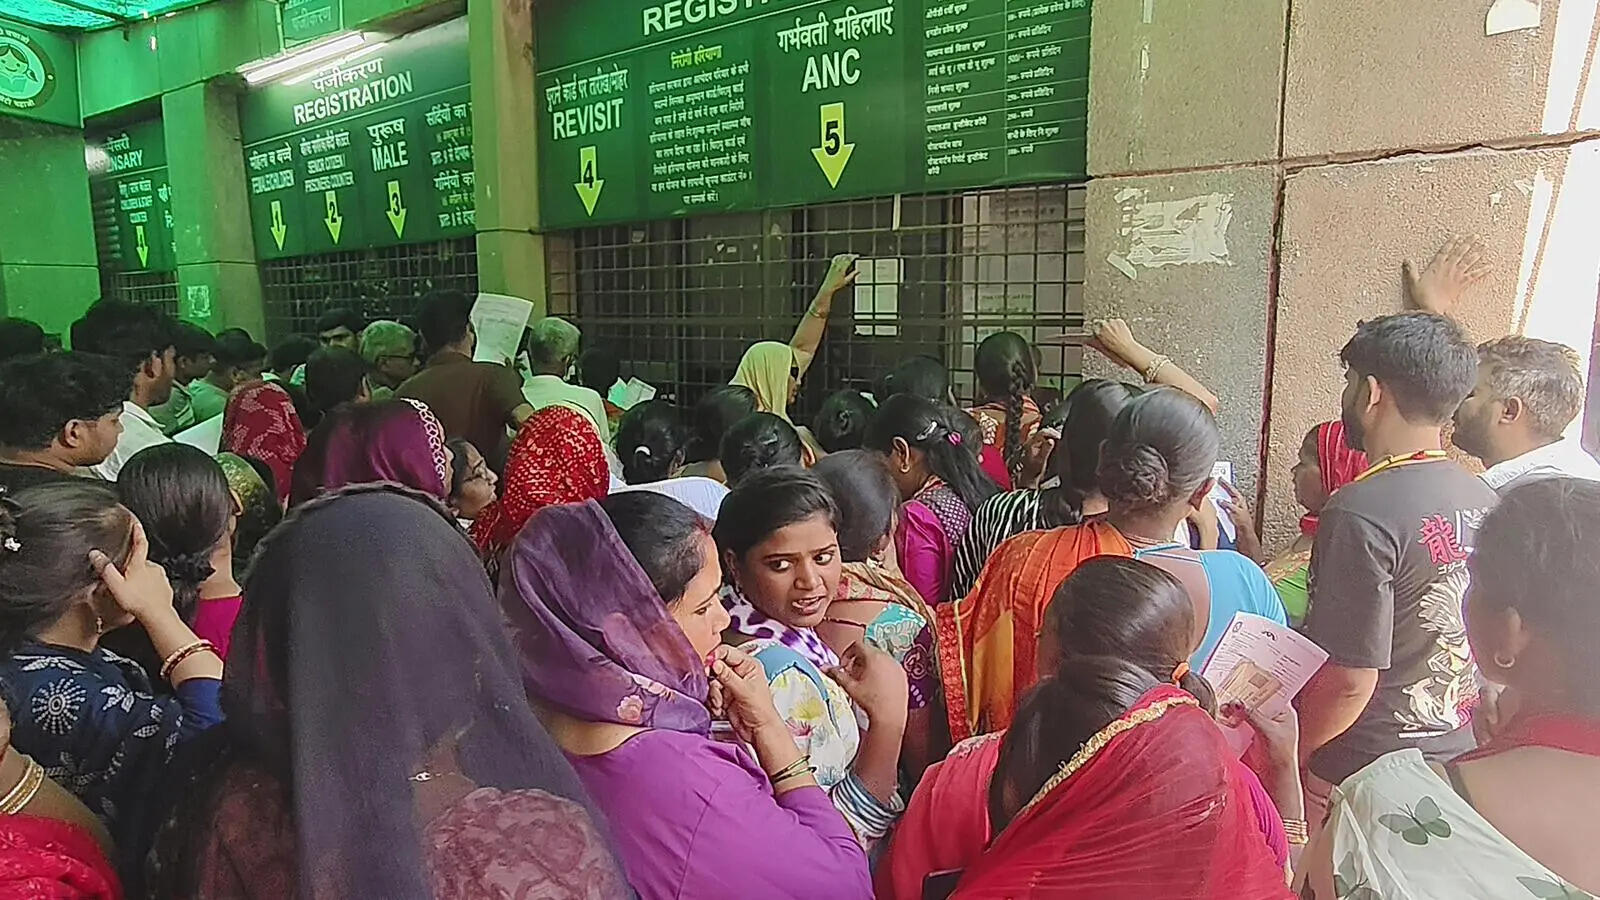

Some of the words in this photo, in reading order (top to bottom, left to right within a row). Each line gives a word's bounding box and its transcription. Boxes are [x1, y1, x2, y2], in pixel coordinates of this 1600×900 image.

[776, 12, 829, 52] गर्भवती
[312, 58, 383, 92] पंजीकरण
[801, 48, 860, 93] ANC
[293, 71, 413, 125] REGISTRATION
[577, 79, 588, 98] पर
[452, 104, 467, 119] का
[553, 98, 624, 140] REVISIT
[825, 120, 840, 156] 5
[371, 141, 409, 172] MALE
[583, 160, 594, 189] 4
[329, 202, 337, 224] 2
[392, 193, 401, 217] 3
[1418, 514, 1467, 565] 龍
